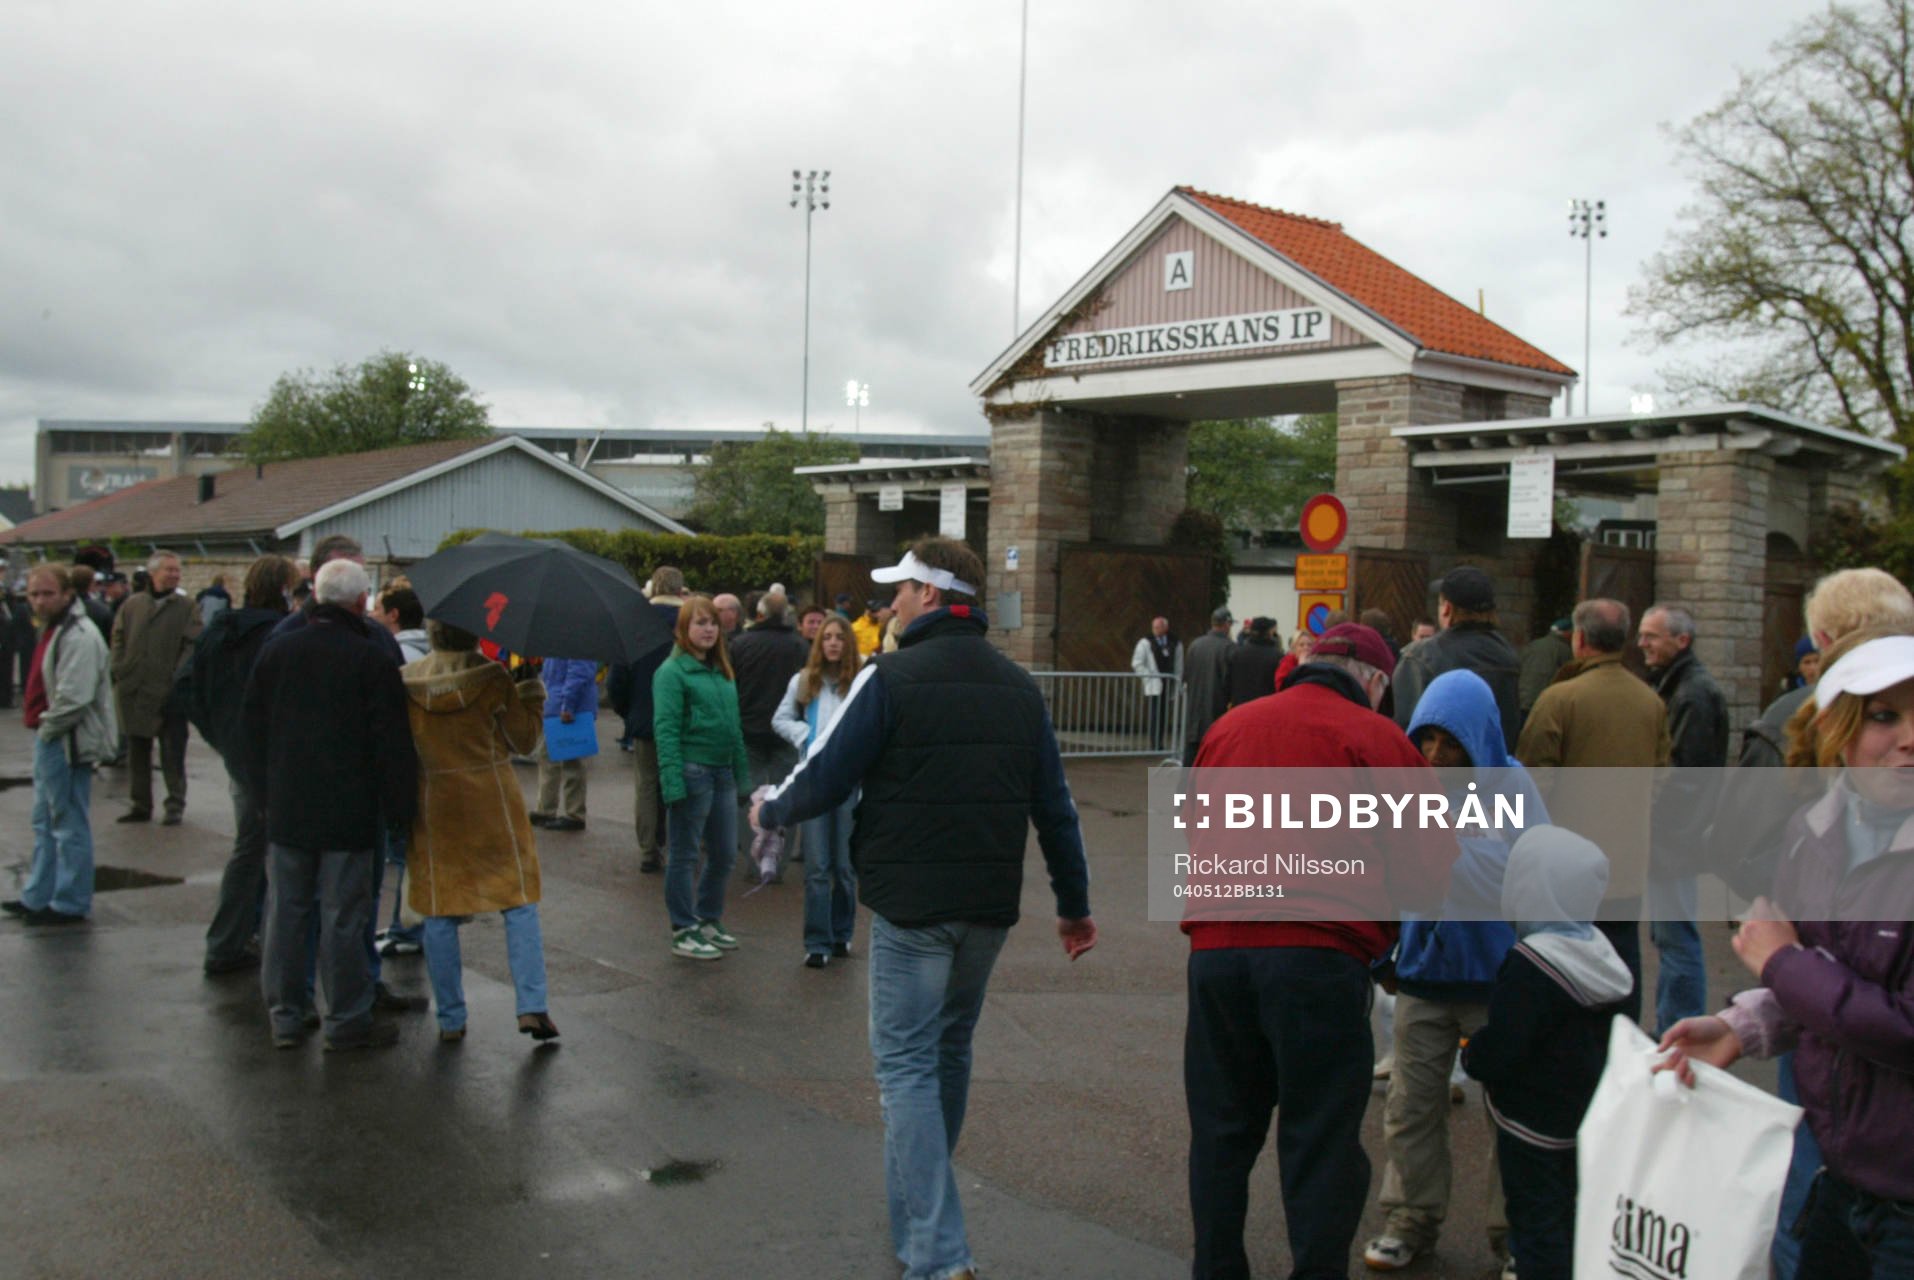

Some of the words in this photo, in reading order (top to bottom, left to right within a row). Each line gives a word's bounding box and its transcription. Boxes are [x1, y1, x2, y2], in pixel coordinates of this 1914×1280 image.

[1169, 258, 1188, 286] A
[1050, 315, 1280, 363] FREDRIKSSKANS
[1290, 311, 1323, 340] IP
